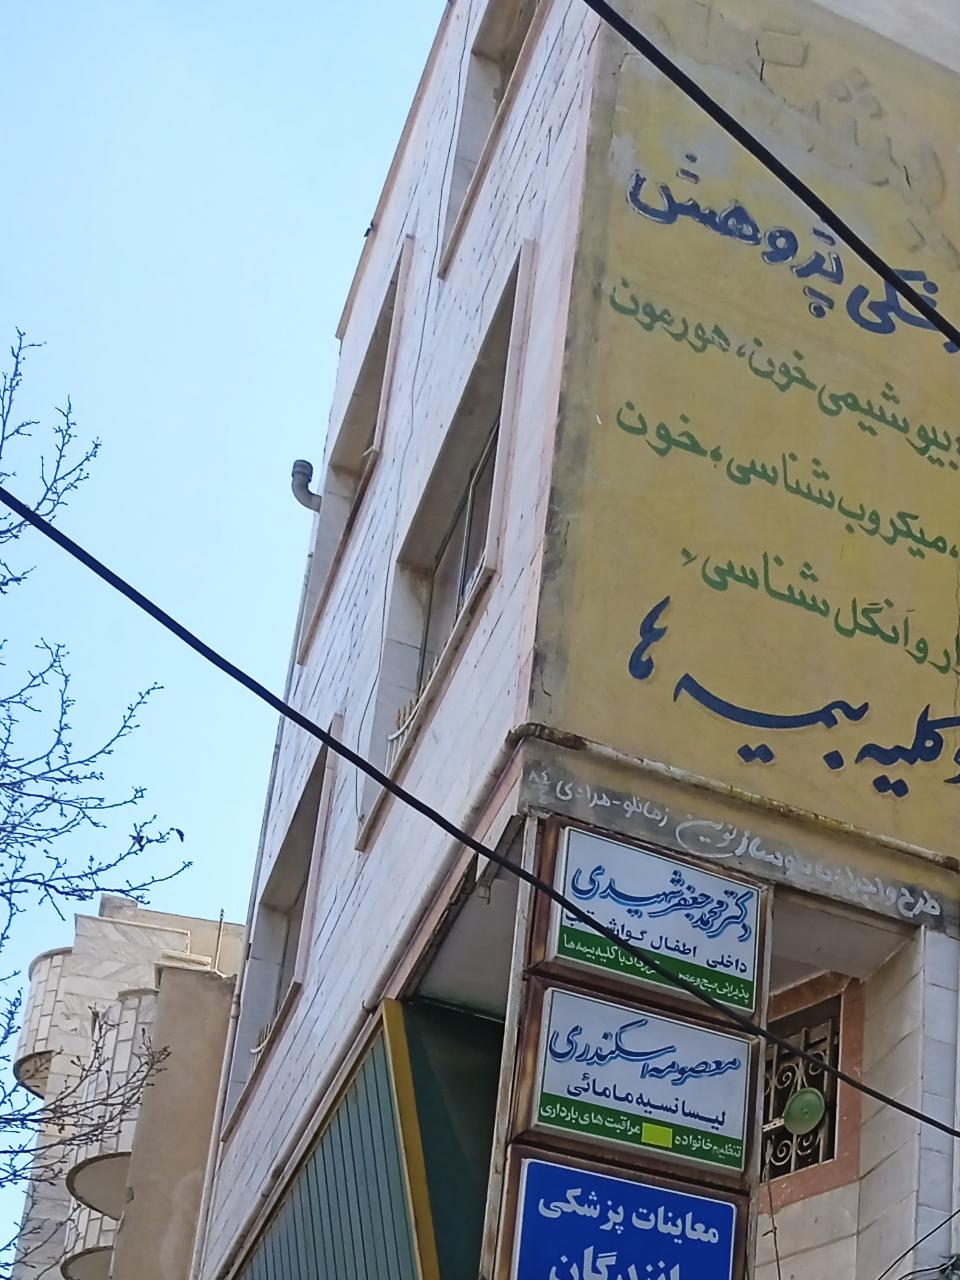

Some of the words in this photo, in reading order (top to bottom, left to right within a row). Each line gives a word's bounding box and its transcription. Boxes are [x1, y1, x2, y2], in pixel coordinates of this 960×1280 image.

[626, 153, 844, 318] پژوهش
[609, 276, 731, 353] هورمون
[615, 401, 708, 457] خون
[837, 496, 948, 559] میکروب
[904, 637, 929, 665] و
[672, 672, 870, 771] بیمه
[571, 864, 686, 920] شهیدی
[706, 889, 755, 943] دکتر
[650, 935, 697, 958] اطفال
[706, 954, 748, 974] داخلی
[549, 1018, 677, 1080] اسکندری
[567, 1072, 634, 1104] مامائی
[649, 1057, 741, 1086] معصومه
[540, 1102, 579, 1122] بارداری
[578, 1108, 605, 1126] های
[605, 1115, 641, 1135] مراقبت
[636, 1093, 727, 1131] لیسانسیه
[674, 1131, 713, 1150] خانواده
[712, 1144, 742, 1159] تنظیم
[538, 1187, 625, 1235] پزشکی
[631, 1206, 720, 1244] معاینات
